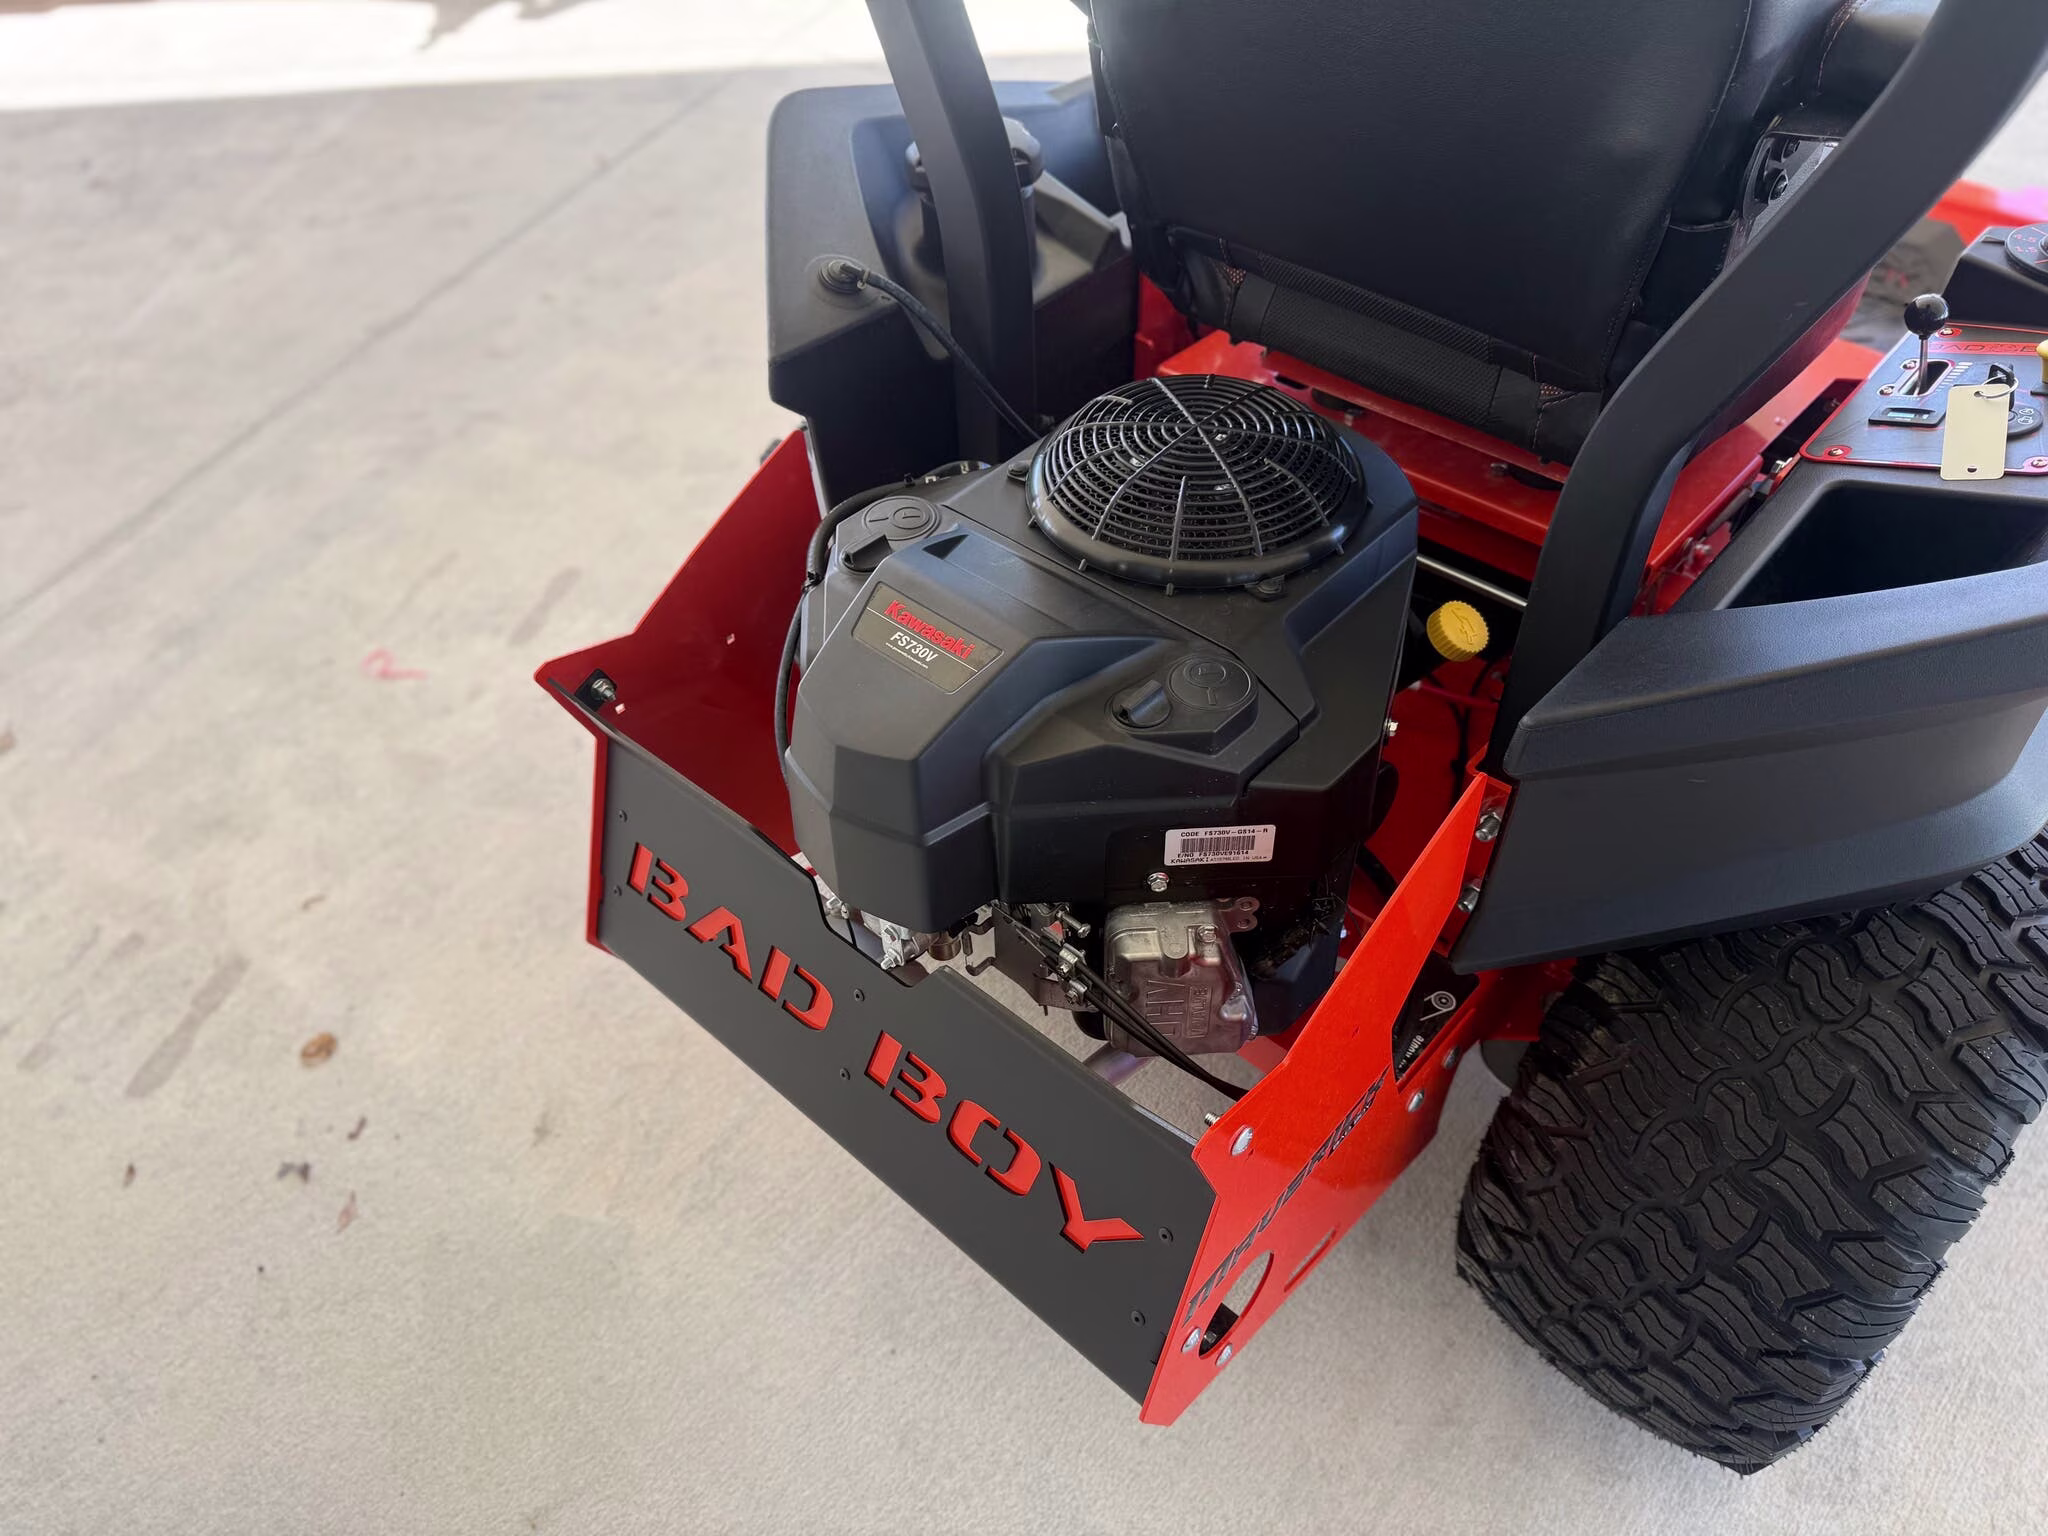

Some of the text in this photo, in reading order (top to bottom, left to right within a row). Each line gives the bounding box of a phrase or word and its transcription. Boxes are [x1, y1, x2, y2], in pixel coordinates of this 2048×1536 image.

[884, 600, 976, 660] Kawasaki
[890, 631, 939, 662] FS730V
[627, 842, 1145, 1253] BAD BOY
